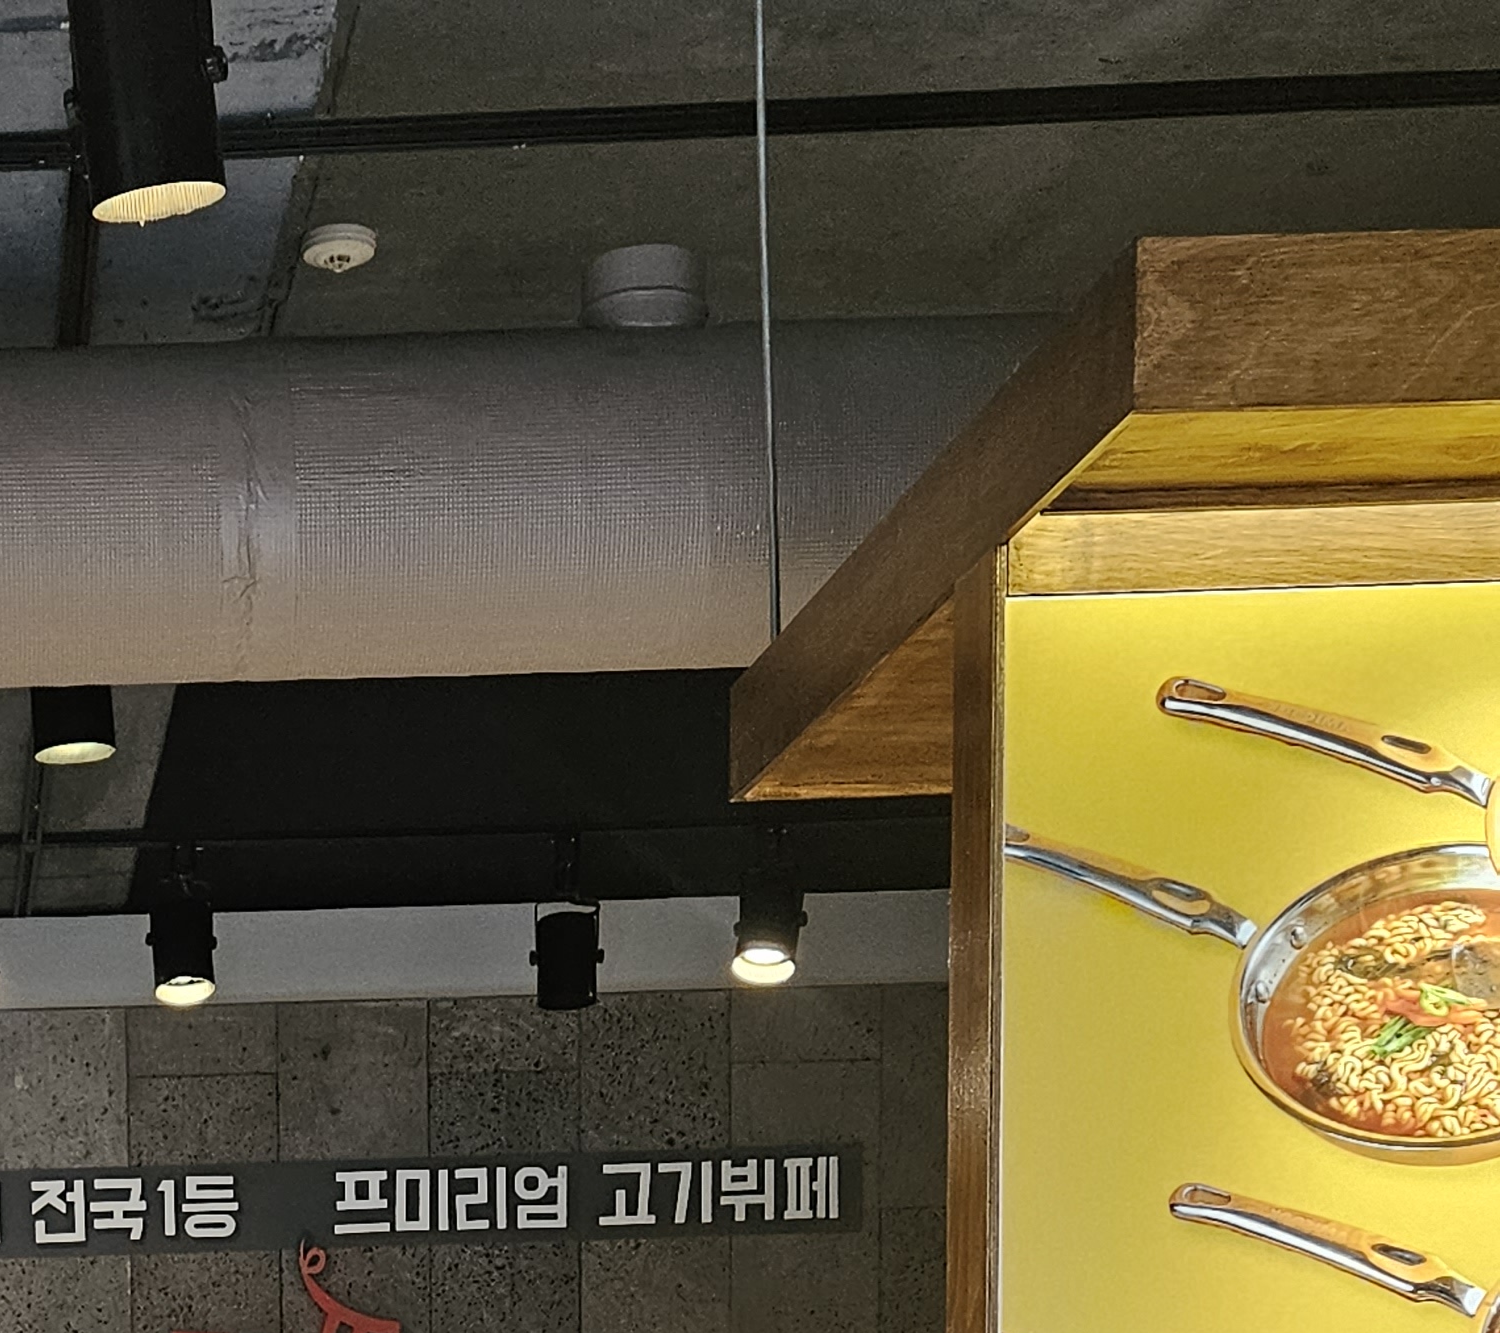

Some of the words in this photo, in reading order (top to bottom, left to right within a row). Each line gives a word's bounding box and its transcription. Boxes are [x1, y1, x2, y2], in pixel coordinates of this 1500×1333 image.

[30, 1175, 240, 1245] 전국1등
[334, 1165, 568, 1235] 프미리엄
[598, 1156, 839, 1226] 고기뷔페
